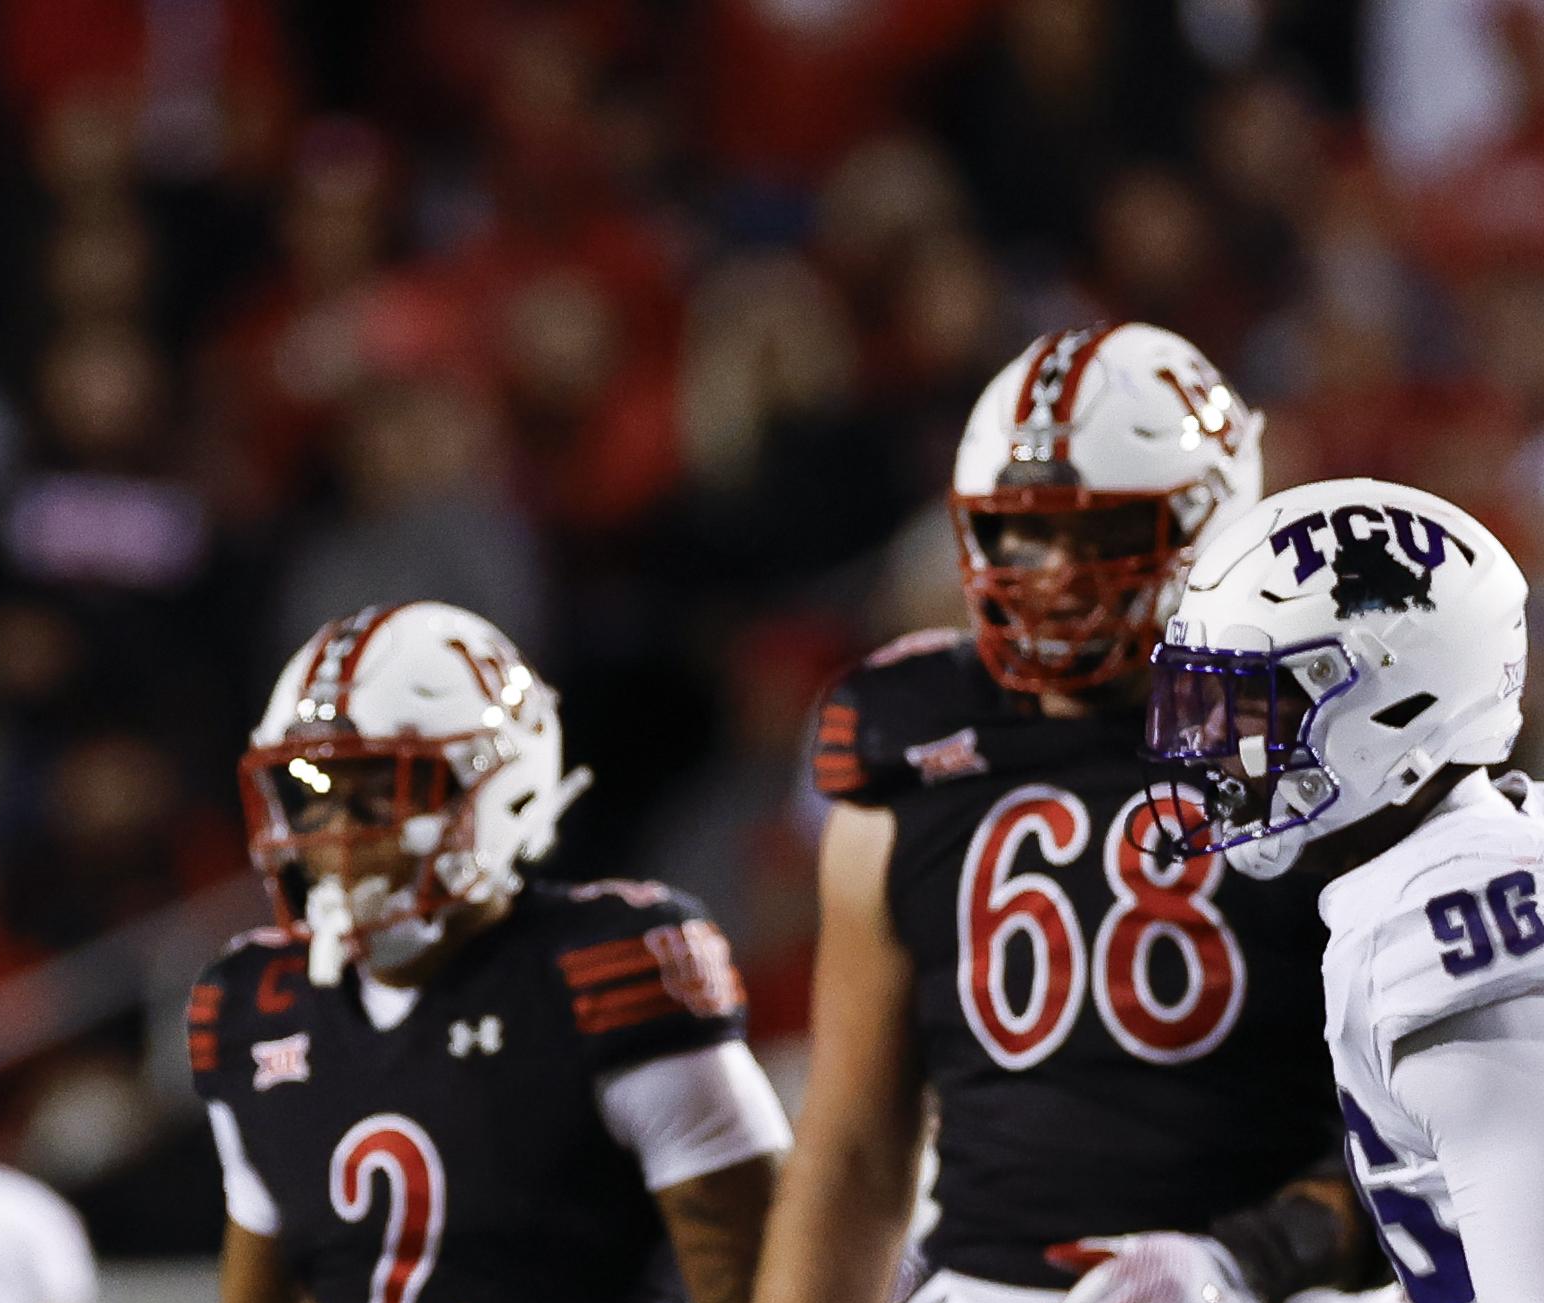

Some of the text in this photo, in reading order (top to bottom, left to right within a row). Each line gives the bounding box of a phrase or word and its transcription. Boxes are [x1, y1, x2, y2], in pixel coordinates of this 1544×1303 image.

[1269, 505, 1448, 586] TCU
[957, 784, 1247, 1072] 68
[1426, 869, 1544, 978] 96
